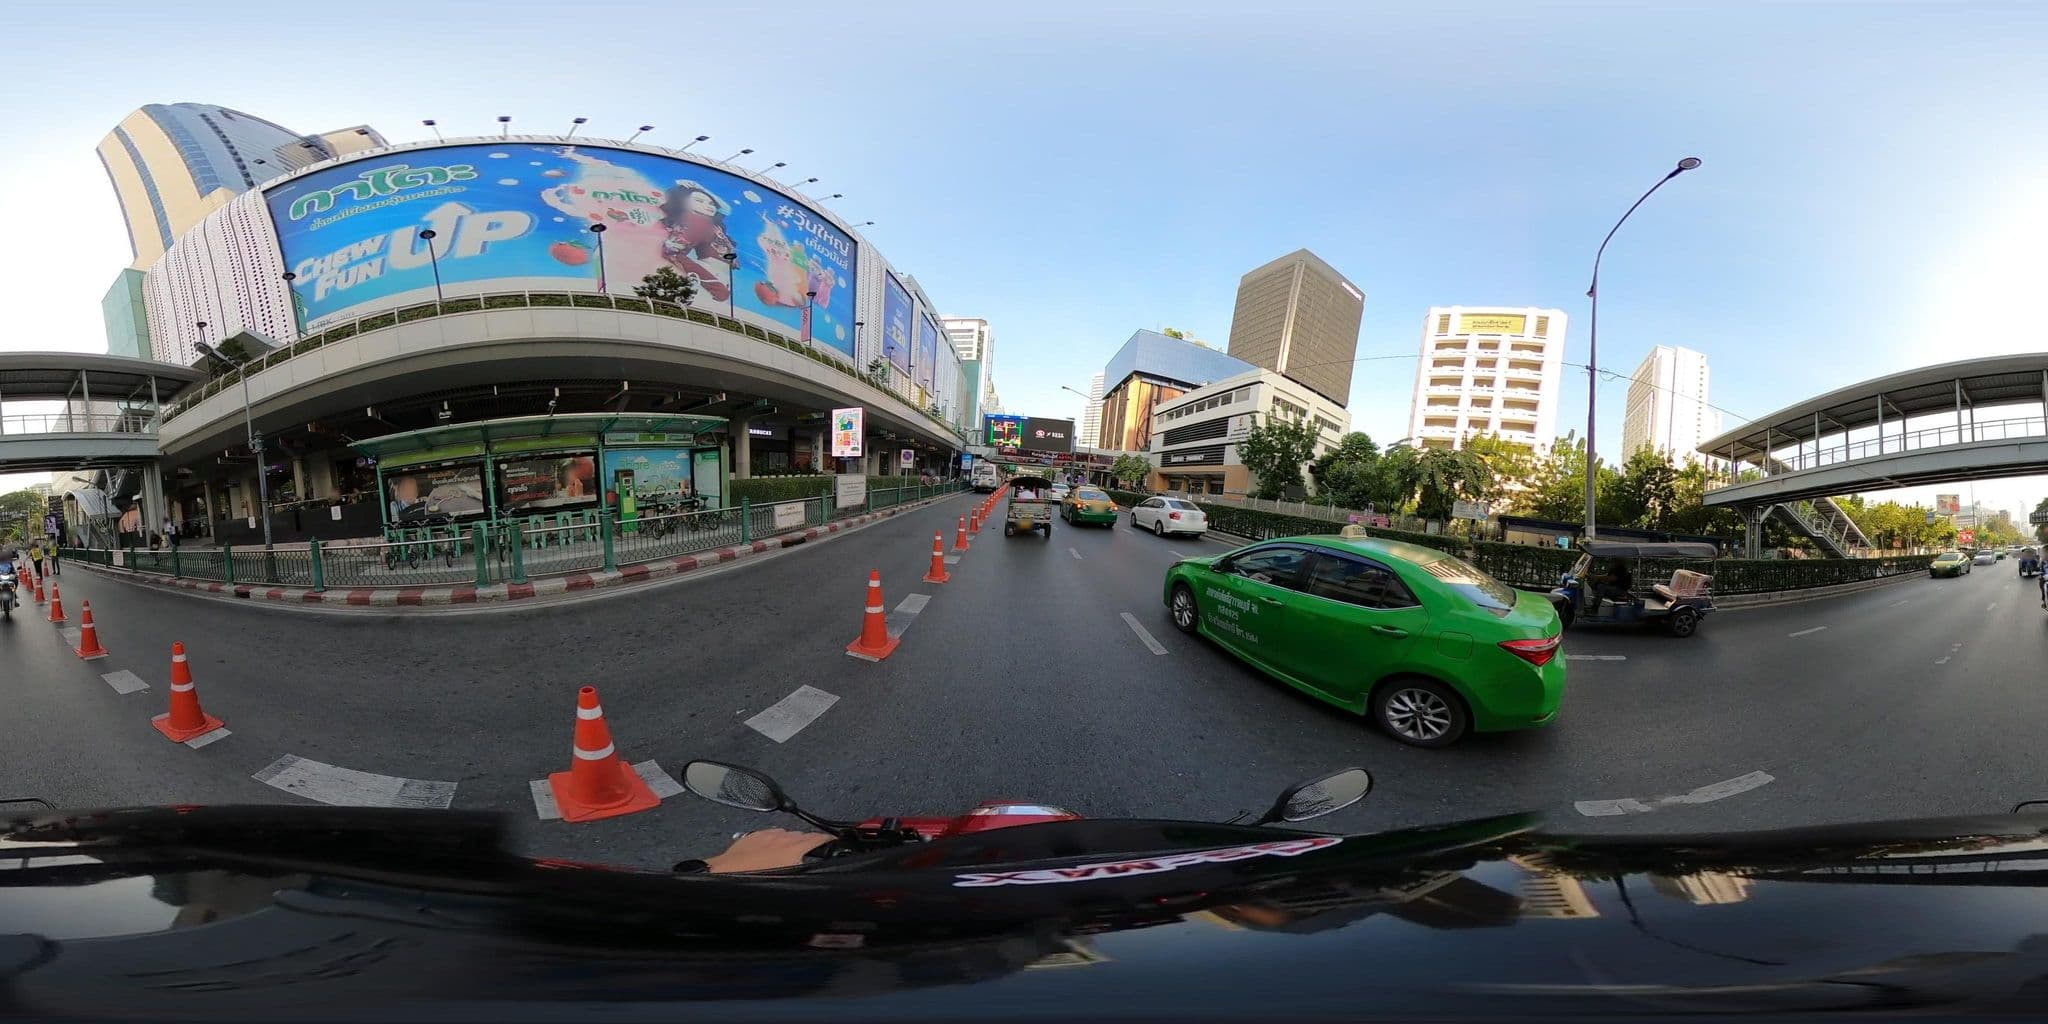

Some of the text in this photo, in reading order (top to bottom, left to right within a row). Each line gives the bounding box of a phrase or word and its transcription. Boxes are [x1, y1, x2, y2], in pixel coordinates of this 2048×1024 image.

[290, 164, 479, 221] กาโตะ
[294, 233, 388, 286] CHEW
[388, 201, 533, 270] UP
[314, 258, 387, 302] FUN
